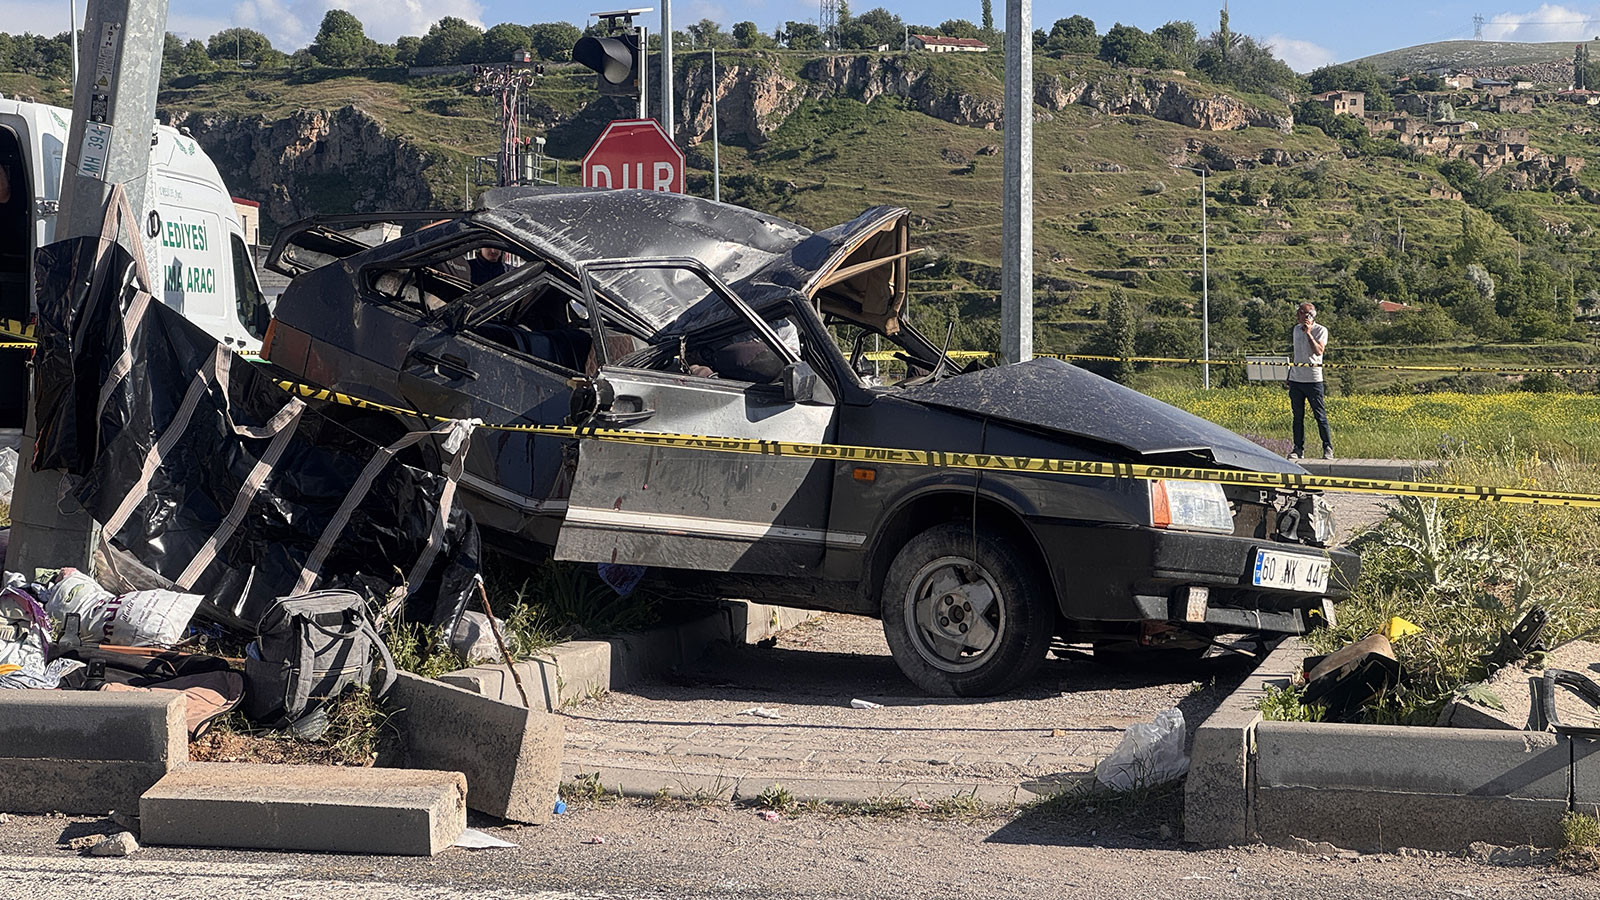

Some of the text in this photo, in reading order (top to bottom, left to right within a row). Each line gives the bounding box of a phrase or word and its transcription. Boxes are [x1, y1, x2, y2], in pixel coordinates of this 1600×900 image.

[87, 128, 106, 150] 394
[82, 155, 101, 173] MH
[160, 215, 208, 251] LEDİYESİ
[187, 266, 216, 294] ARACI
[1262, 556, 1276, 581] 60
